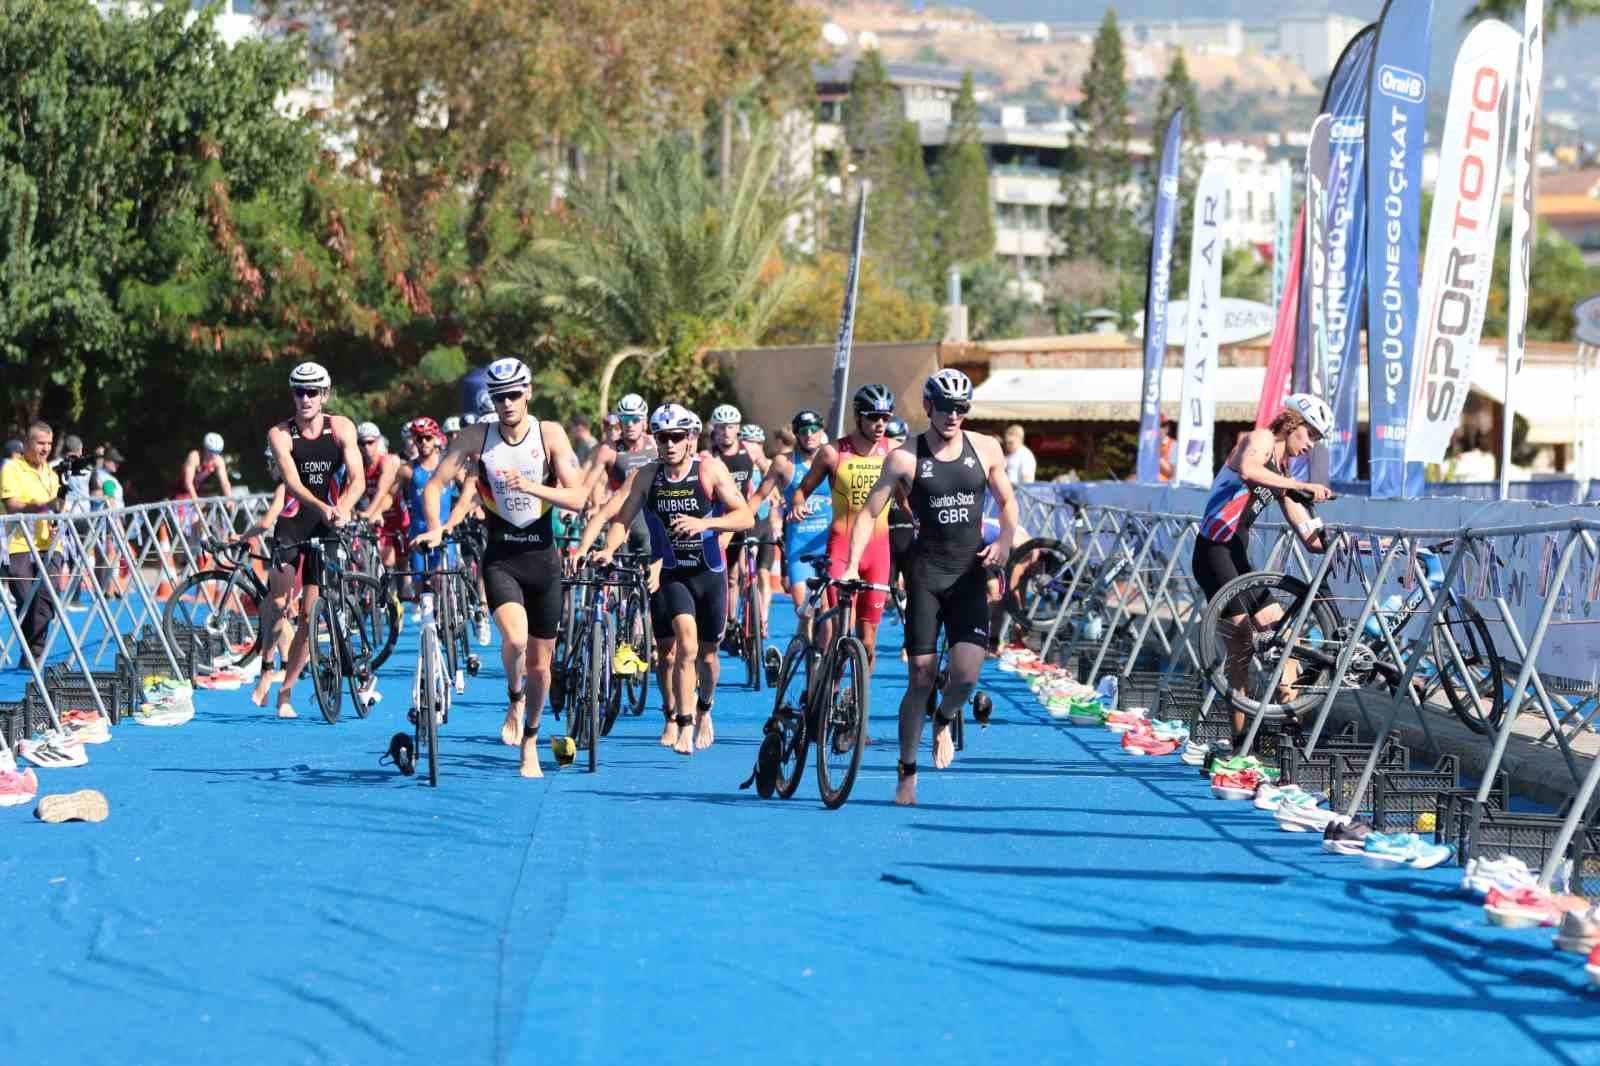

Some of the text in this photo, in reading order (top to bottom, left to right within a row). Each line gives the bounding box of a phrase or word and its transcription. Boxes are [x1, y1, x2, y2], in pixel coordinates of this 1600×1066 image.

[1451, 66, 1500, 241] TOTO
[1426, 247, 1477, 422] SPOR
[309, 473, 324, 485] RUS
[505, 497, 533, 512] GER
[657, 498, 700, 512] HUBNER
[852, 491, 868, 505] ES
[929, 492, 976, 508] Stanton-Stock
[938, 508, 970, 524] GBR
